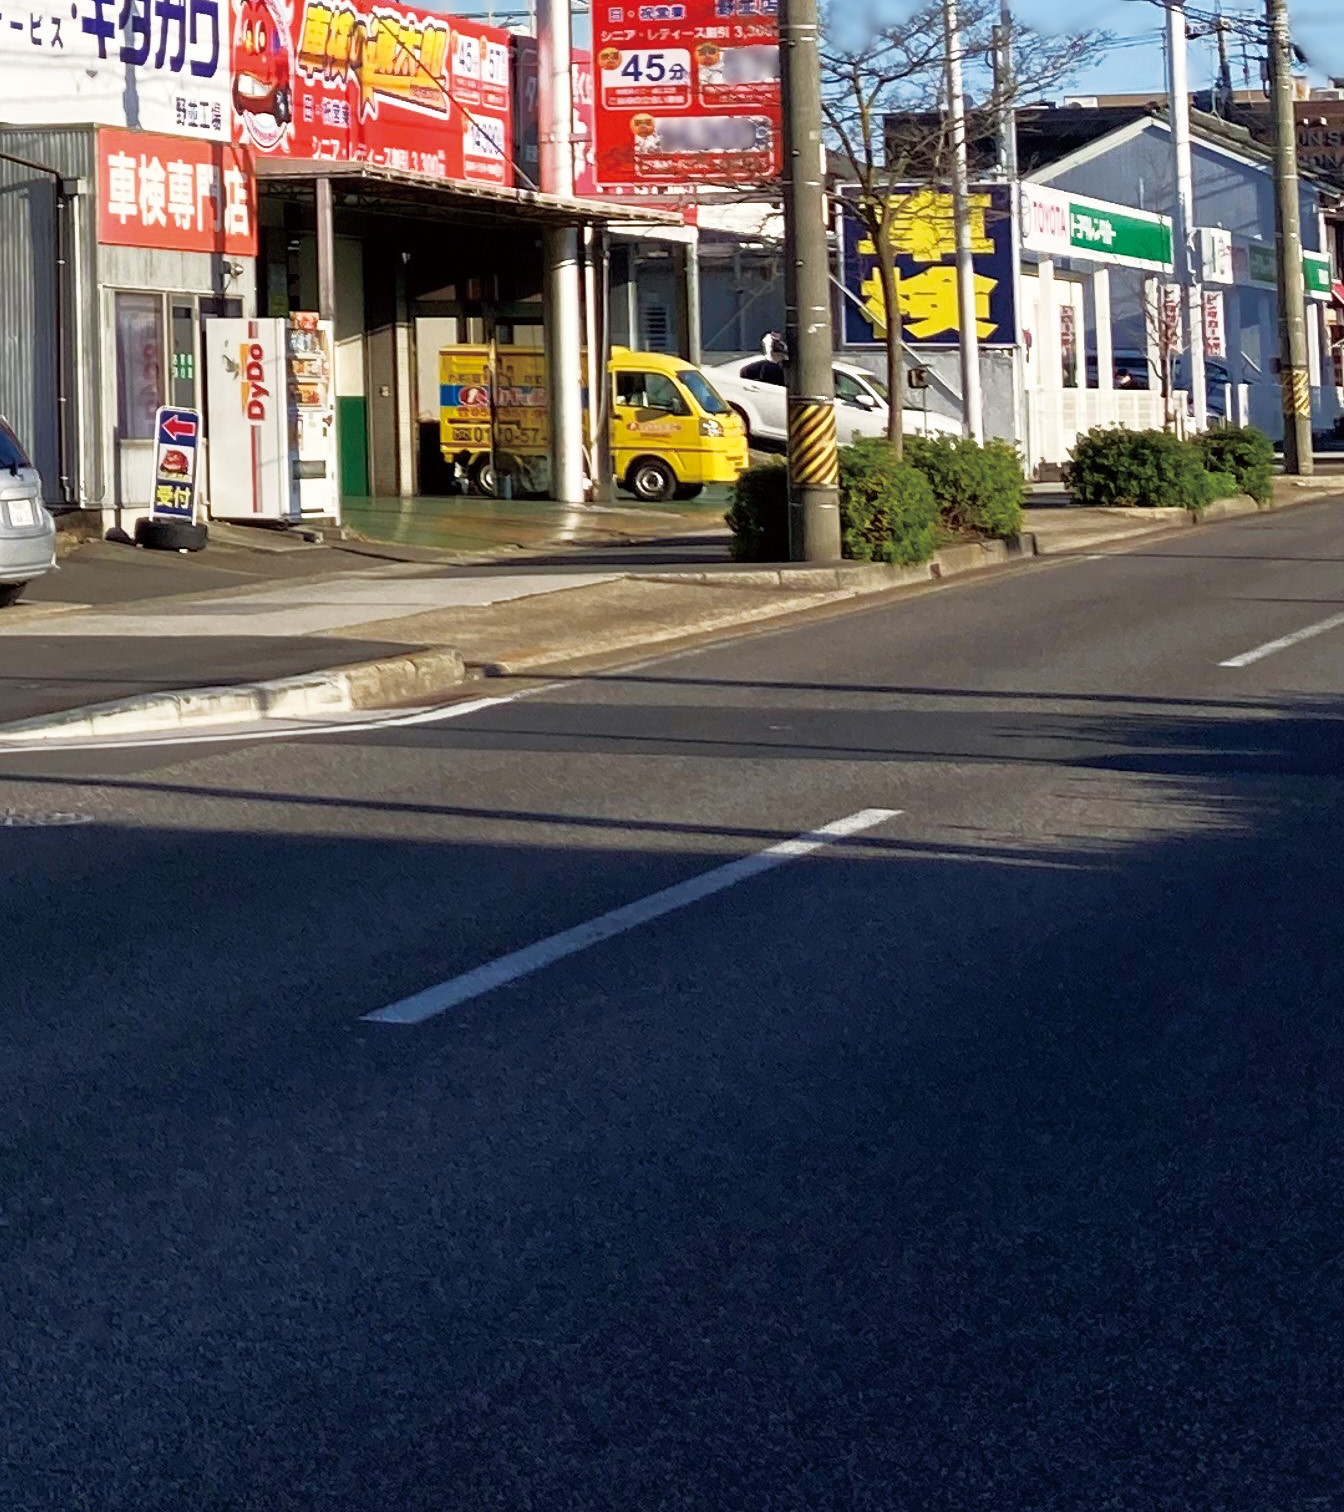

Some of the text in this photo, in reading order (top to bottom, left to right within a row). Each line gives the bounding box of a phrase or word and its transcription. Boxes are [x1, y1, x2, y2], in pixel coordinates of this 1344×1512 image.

[108, 150, 249, 237] 車検専門店
[246, 343, 271, 421] DyDo
[156, 485, 192, 509] 受付
